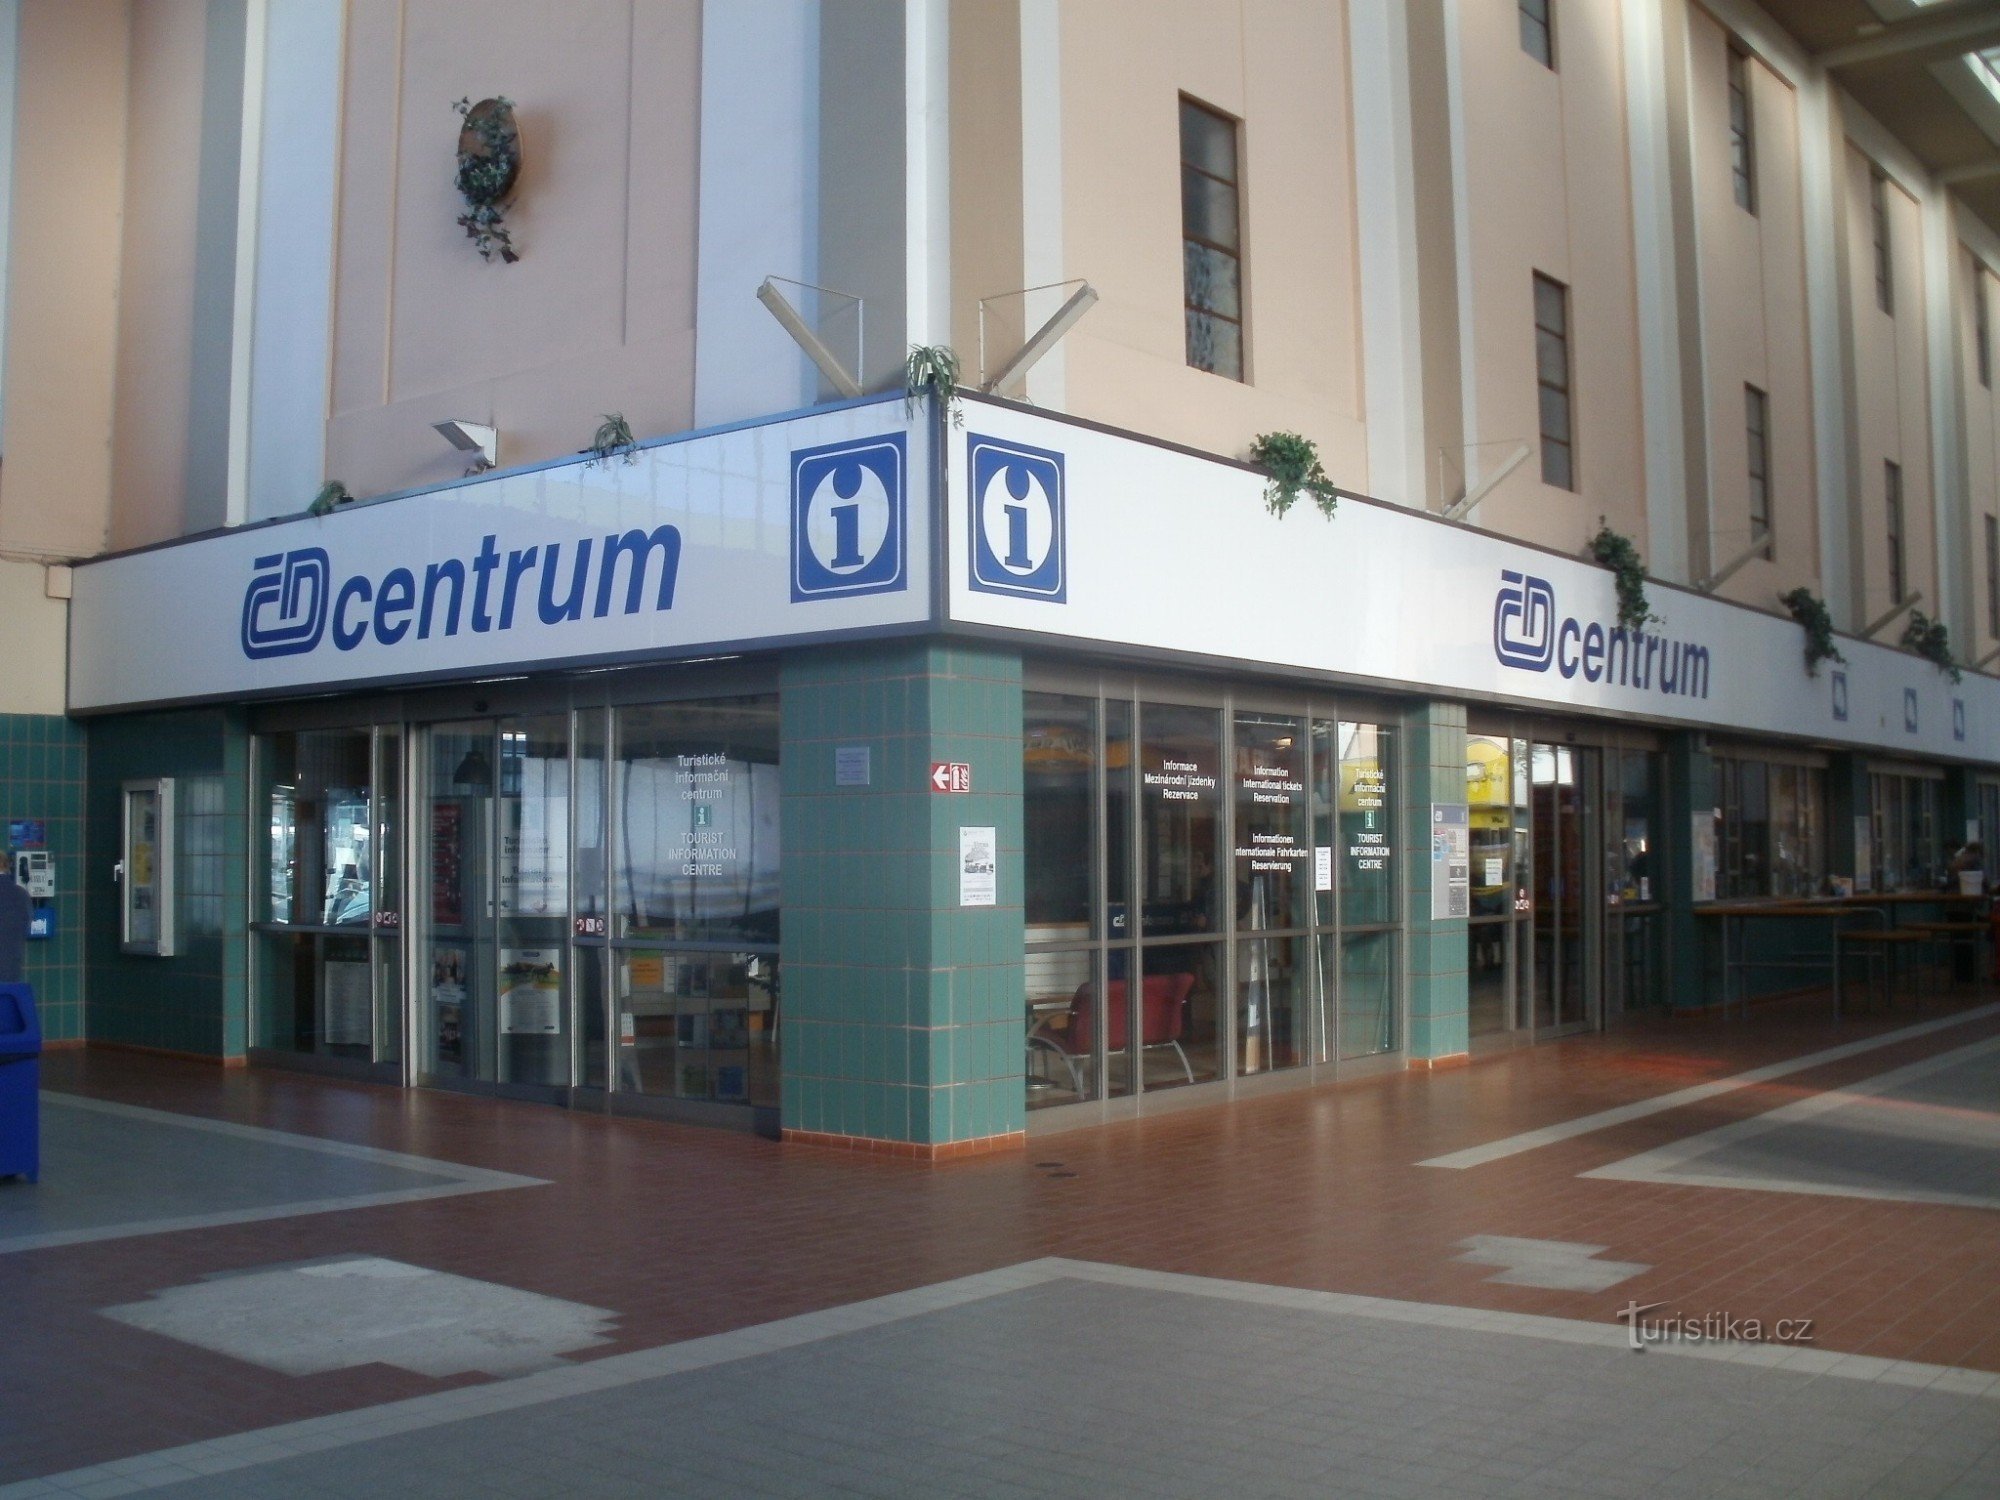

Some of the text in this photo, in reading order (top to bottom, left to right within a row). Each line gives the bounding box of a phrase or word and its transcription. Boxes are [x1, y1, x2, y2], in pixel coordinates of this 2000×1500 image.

[332, 524, 682, 652] centrum
[1558, 617, 1710, 699] centrum
[678, 752, 727, 767] Turistické
[1163, 760, 1198, 772] Informace
[1254, 765, 1289, 778] Information
[675, 769, 729, 783] informační
[1355, 768, 1384, 780] Turistické
[1144, 773, 1216, 789] Mezinárodní jízdenky
[1243, 778, 1303, 792] International tickets
[681, 788, 723, 800] centrum
[1354, 782, 1386, 794] informační
[1163, 788, 1199, 801] Rezervace
[1253, 792, 1290, 804] Reservation
[1357, 797, 1383, 807] centrum
[680, 832, 724, 844] TOURIST
[1252, 833, 1294, 845] Informationen
[1357, 833, 1384, 844] TOURIST
[668, 847, 737, 860] INFORMATION
[1235, 847, 1309, 858] nternationale Fahrkarten
[1350, 846, 1391, 857] INFORMATION
[681, 863, 723, 876] CENTRE
[1251, 860, 1293, 873] Reservierung
[1358, 859, 1383, 870] CENTRE
